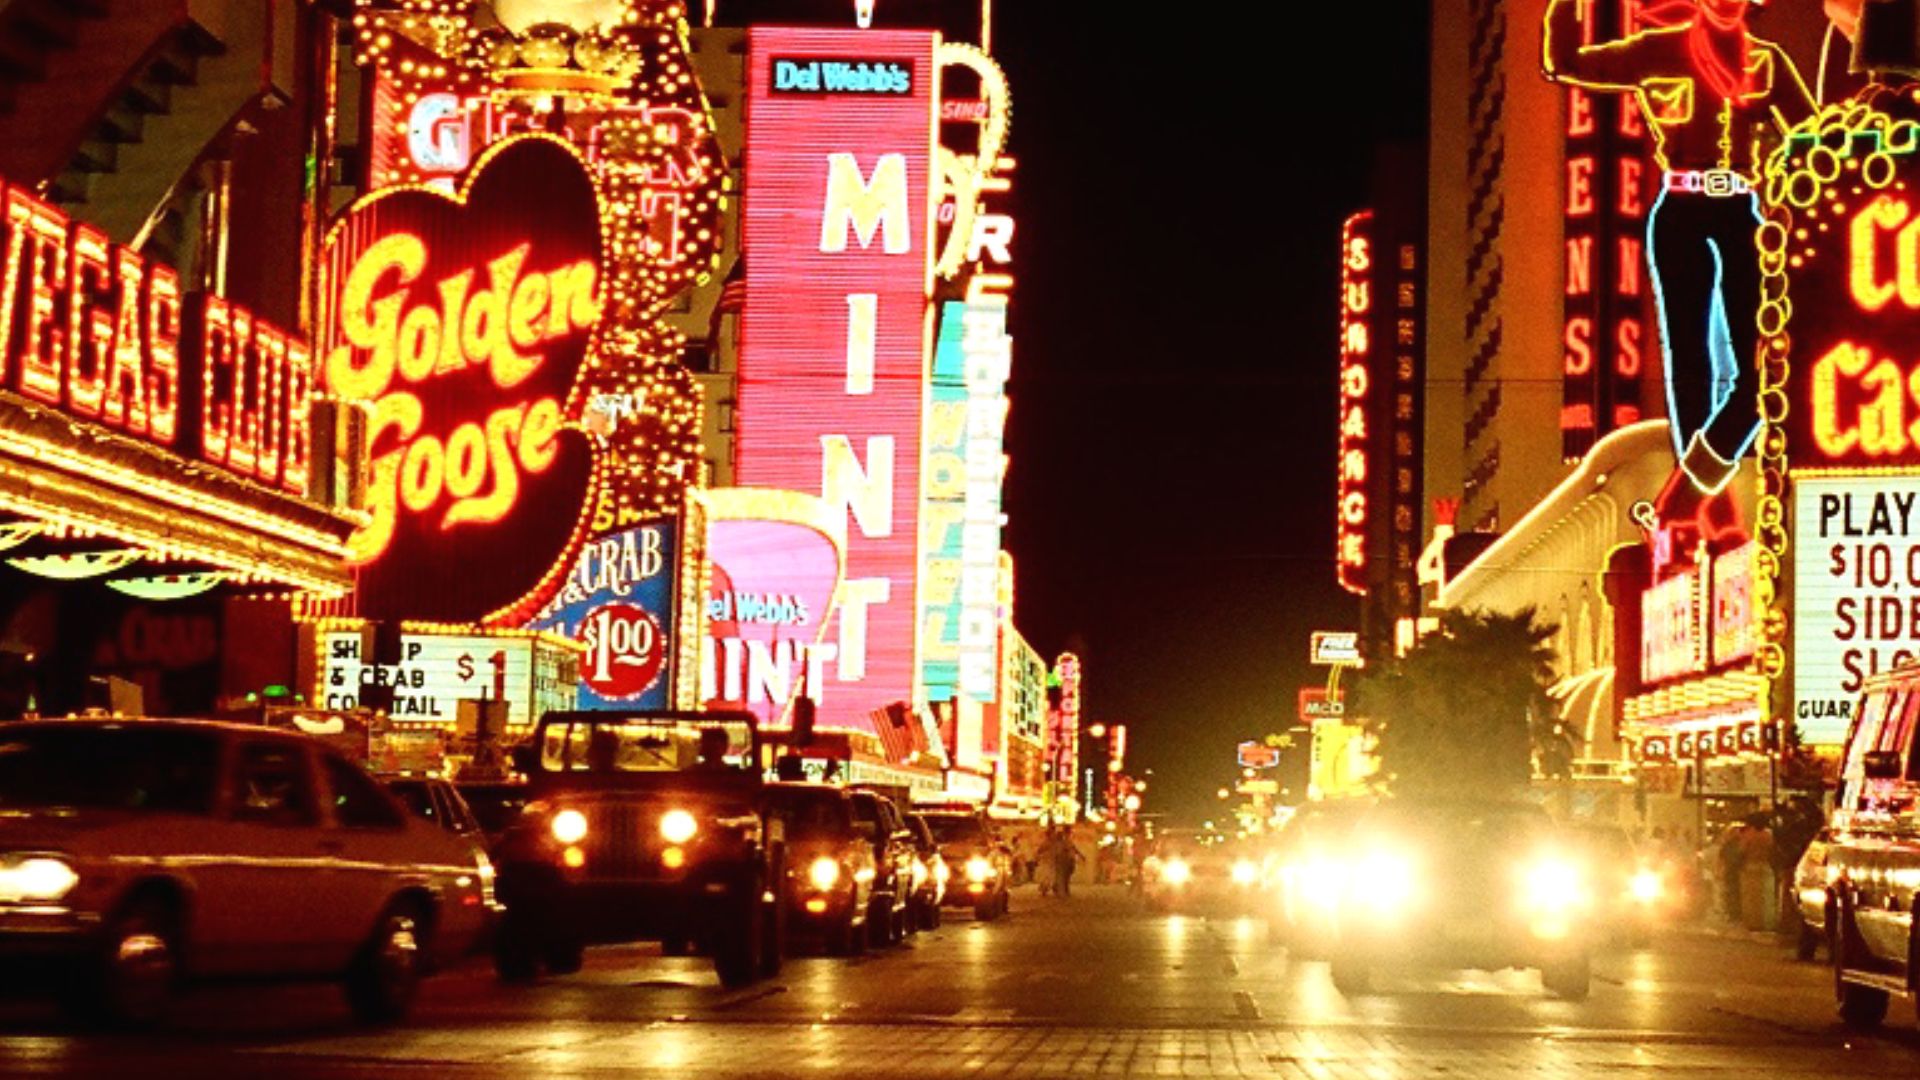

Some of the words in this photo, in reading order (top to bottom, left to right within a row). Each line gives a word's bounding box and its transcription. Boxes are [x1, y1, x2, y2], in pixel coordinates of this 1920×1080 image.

[775, 61, 820, 90] Del
[821, 61, 910, 93] Webb's
[325, 232, 602, 402] Golden
[202, 296, 310, 494] CLUB
[818, 151, 911, 697] MINT
[1345, 236, 1371, 567] SUNDANCE
[1812, 340, 1920, 456] Ca
[340, 391, 562, 567] Goose
[1819, 491, 1916, 538] PLAY
[580, 526, 662, 597] CRAB
[331, 639, 422, 661] SHP
[357, 667, 425, 689] CRAB
[327, 693, 442, 716] COTAIL
[1798, 699, 1851, 719] GUAR
